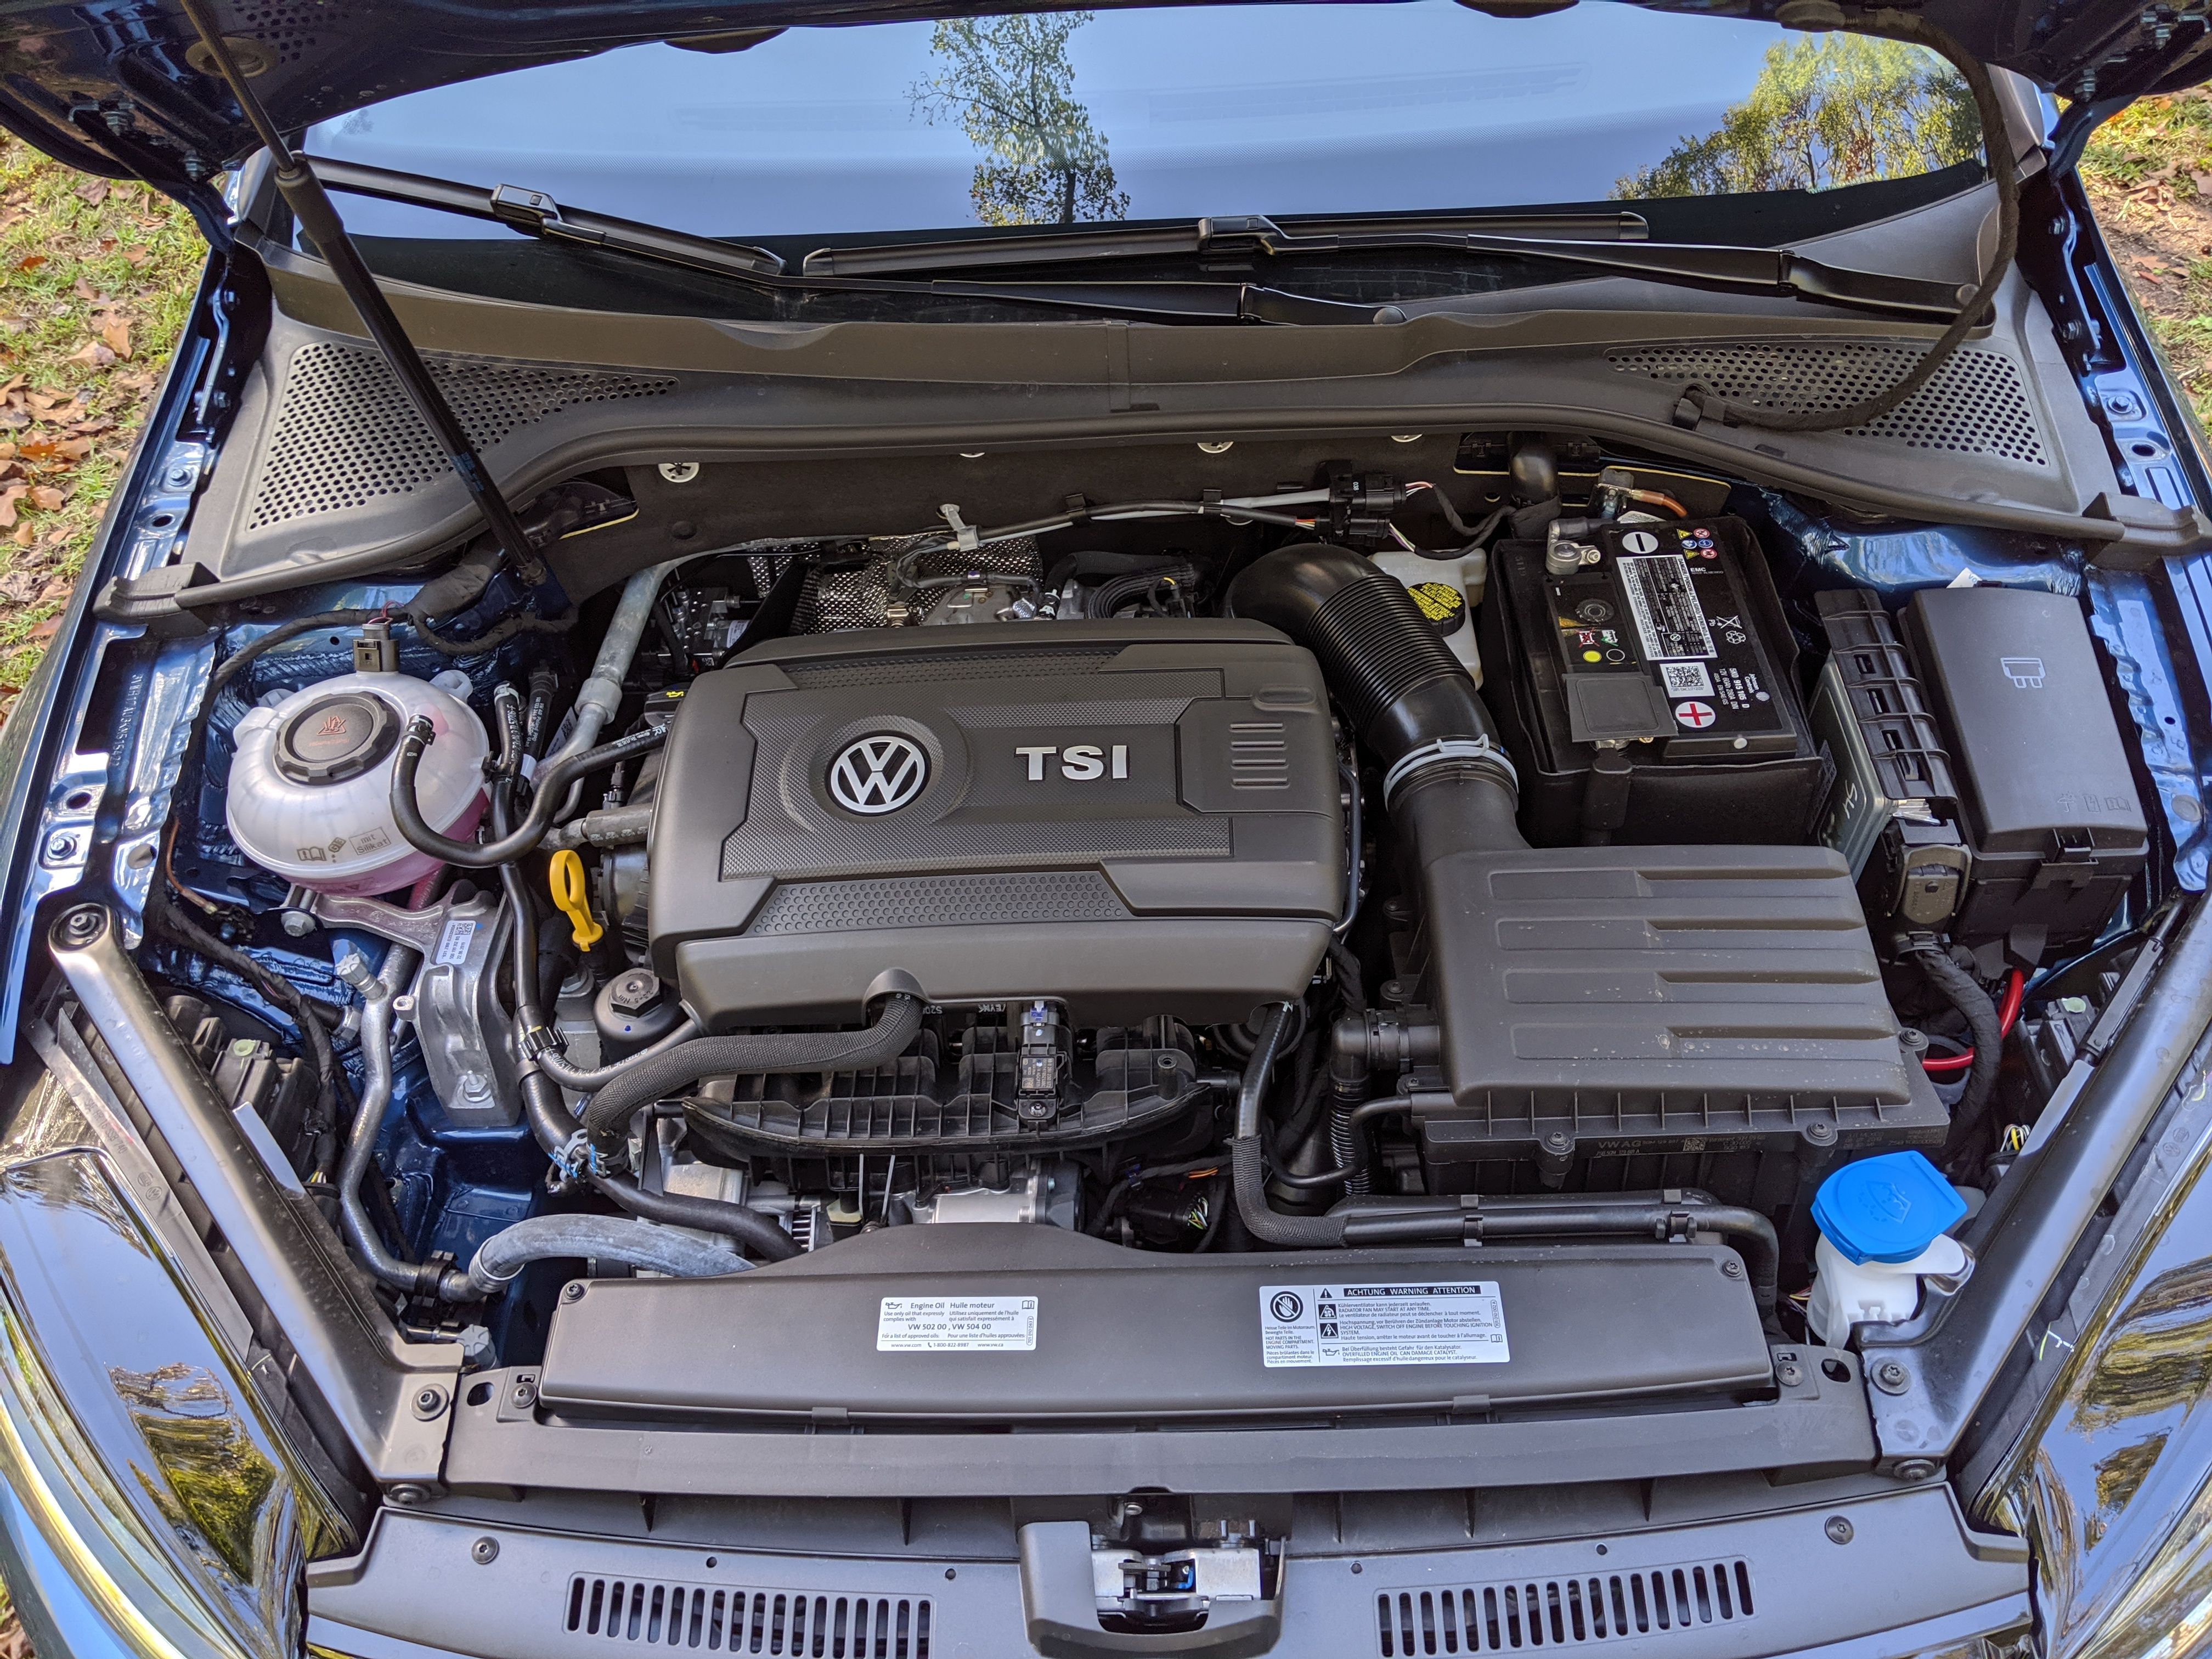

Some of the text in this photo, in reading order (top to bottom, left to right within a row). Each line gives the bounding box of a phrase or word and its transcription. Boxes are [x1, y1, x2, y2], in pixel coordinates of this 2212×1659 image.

[1734, 680, 1743, 690] 915
[1744, 676, 1755, 693] Controls
[1748, 674, 1759, 690] Johnson
[1737, 691, 1747, 700] 105
[1014, 745, 1130, 781] TSI
[828, 733, 928, 814] VW
[360, 834, 375, 843] mit
[357, 839, 389, 854] Silikat
[619, 994, 630, 1004] Nm
